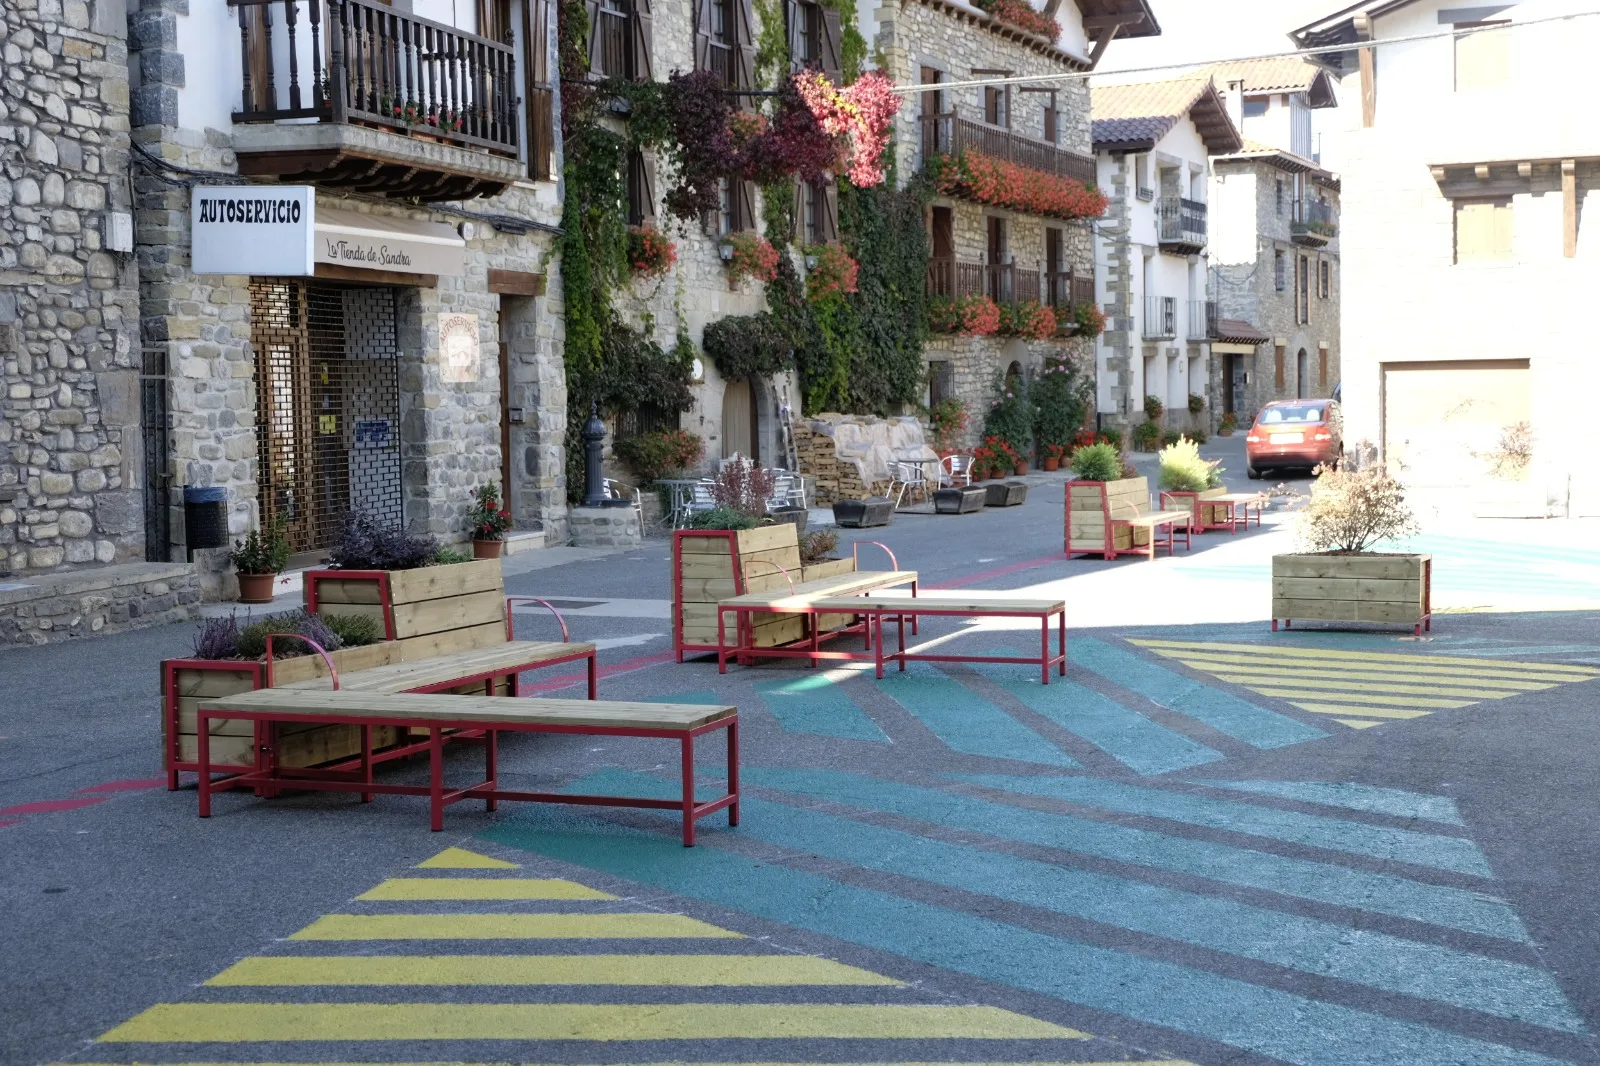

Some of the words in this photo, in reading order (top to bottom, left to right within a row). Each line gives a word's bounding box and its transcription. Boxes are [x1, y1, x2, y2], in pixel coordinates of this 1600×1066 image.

[326, 238, 338, 258] La
[337, 241, 366, 261] Tienda
[367, 246, 377, 262] de
[378, 245, 411, 266] Sandra
